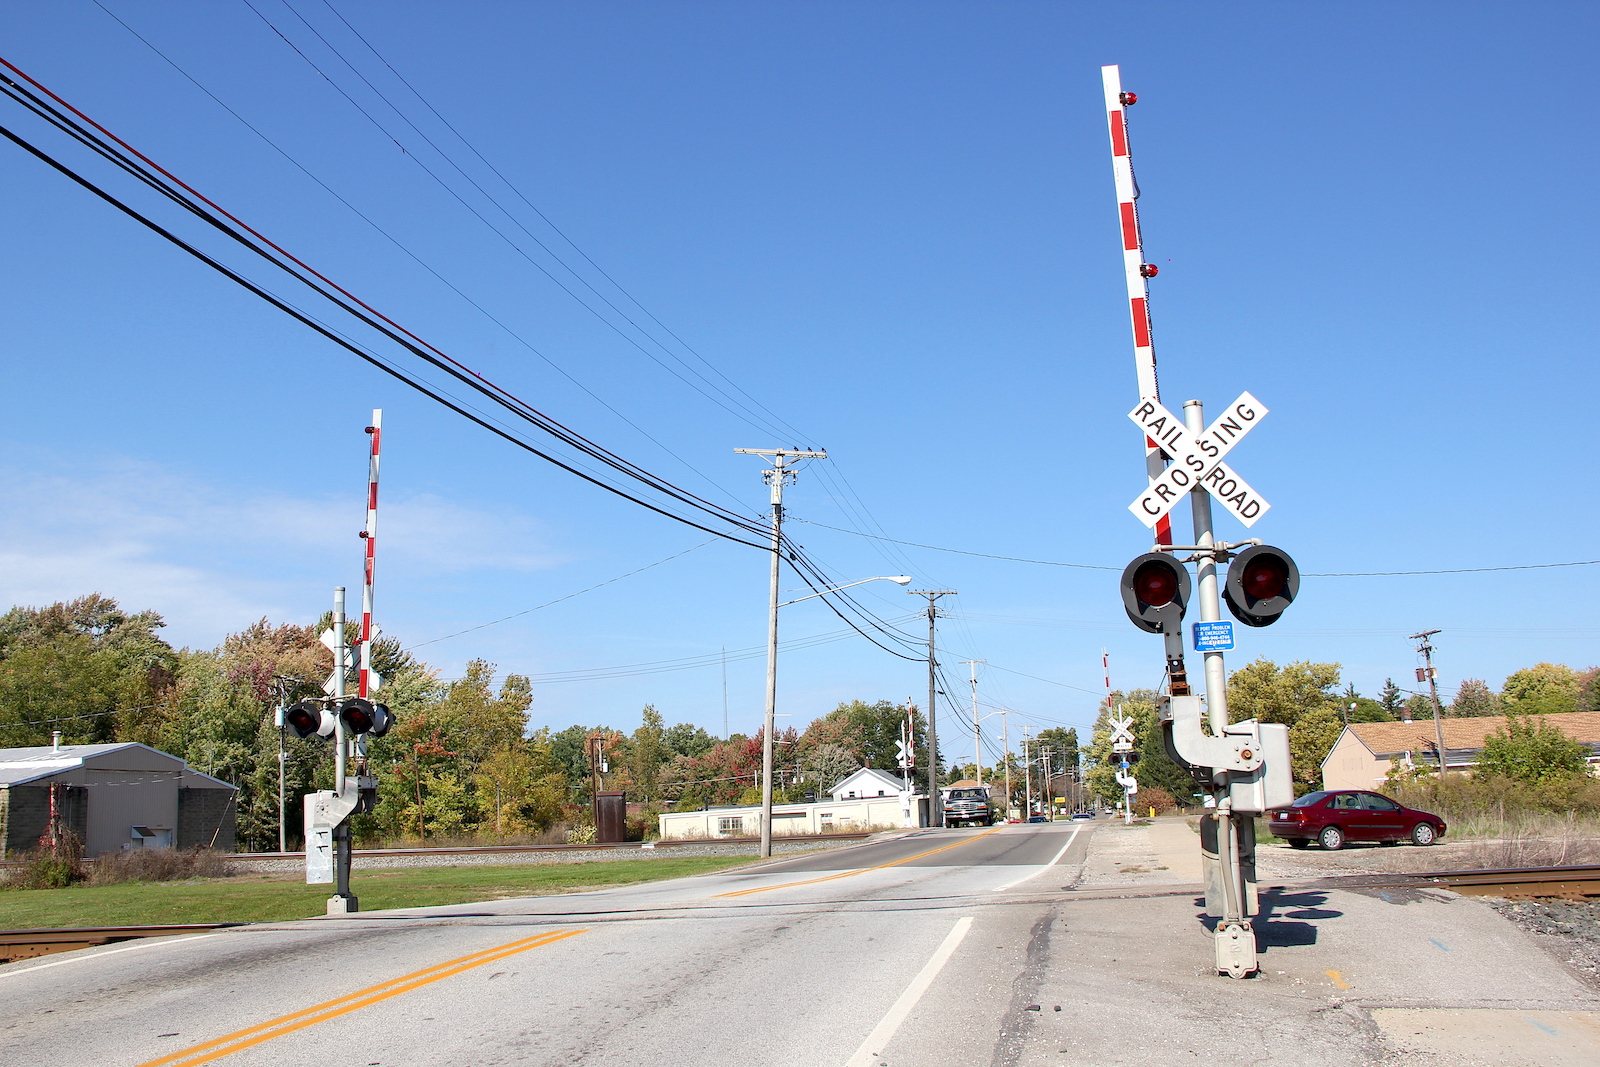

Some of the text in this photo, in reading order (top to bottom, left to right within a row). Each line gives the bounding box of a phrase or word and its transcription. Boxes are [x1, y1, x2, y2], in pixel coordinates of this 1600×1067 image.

[1135, 401, 1260, 518] RAIL ROAD
[1142, 404, 1255, 515] CROSSING
